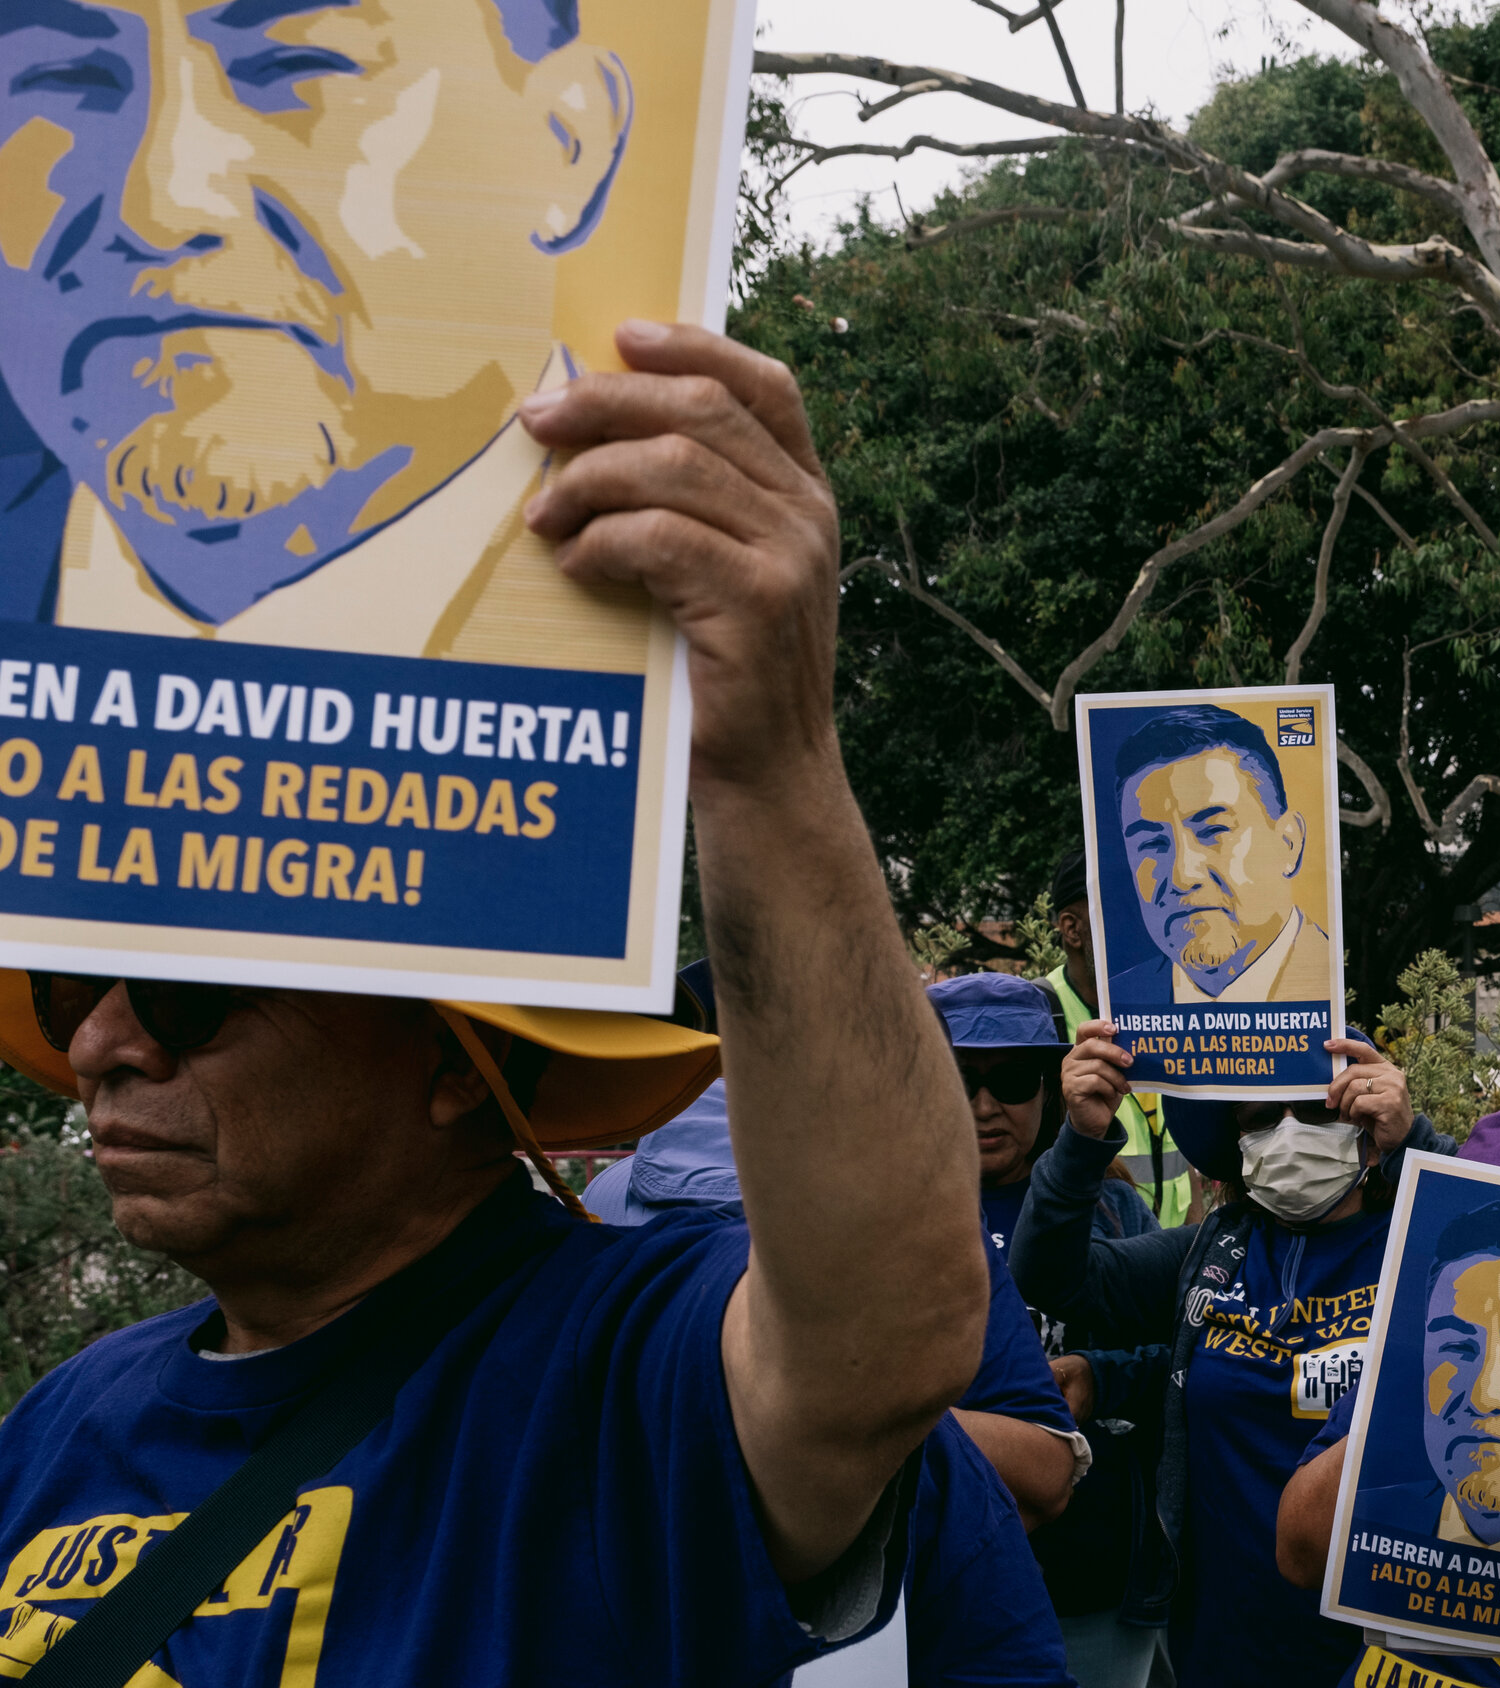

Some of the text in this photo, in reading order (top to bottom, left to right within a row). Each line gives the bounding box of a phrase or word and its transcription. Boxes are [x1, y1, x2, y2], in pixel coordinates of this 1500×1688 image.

[90, 669, 138, 728] A
[154, 674, 354, 745] DAVID
[370, 692, 629, 767] HUERTA!
[1280, 735, 1313, 745] SEIU
[57, 744, 105, 803] A
[124, 749, 244, 814] LAS
[261, 760, 558, 839] REDADAS
[77, 823, 159, 886] LA
[177, 831, 425, 906] MIGRA!
[1114, 1011, 1328, 1034] ¡LIBEREN A DAVID HUERTA!
[1131, 1034, 1309, 1057] ¡ALTO A LAS REDADAS
[1163, 1057, 1275, 1076] DE LA MIGRA!
[1204, 1326, 1292, 1365] WEST
[1351, 1531, 1444, 1569] ¡LIBEREN
[1447, 1554, 1462, 1572] A
[1371, 1562, 1431, 1589] ¡ALTO
[1435, 1575, 1450, 1594] A
[1456, 1578, 1495, 1601] LAS
[1408, 1592, 1436, 1614] DE
[1441, 1599, 1466, 1620] LA
